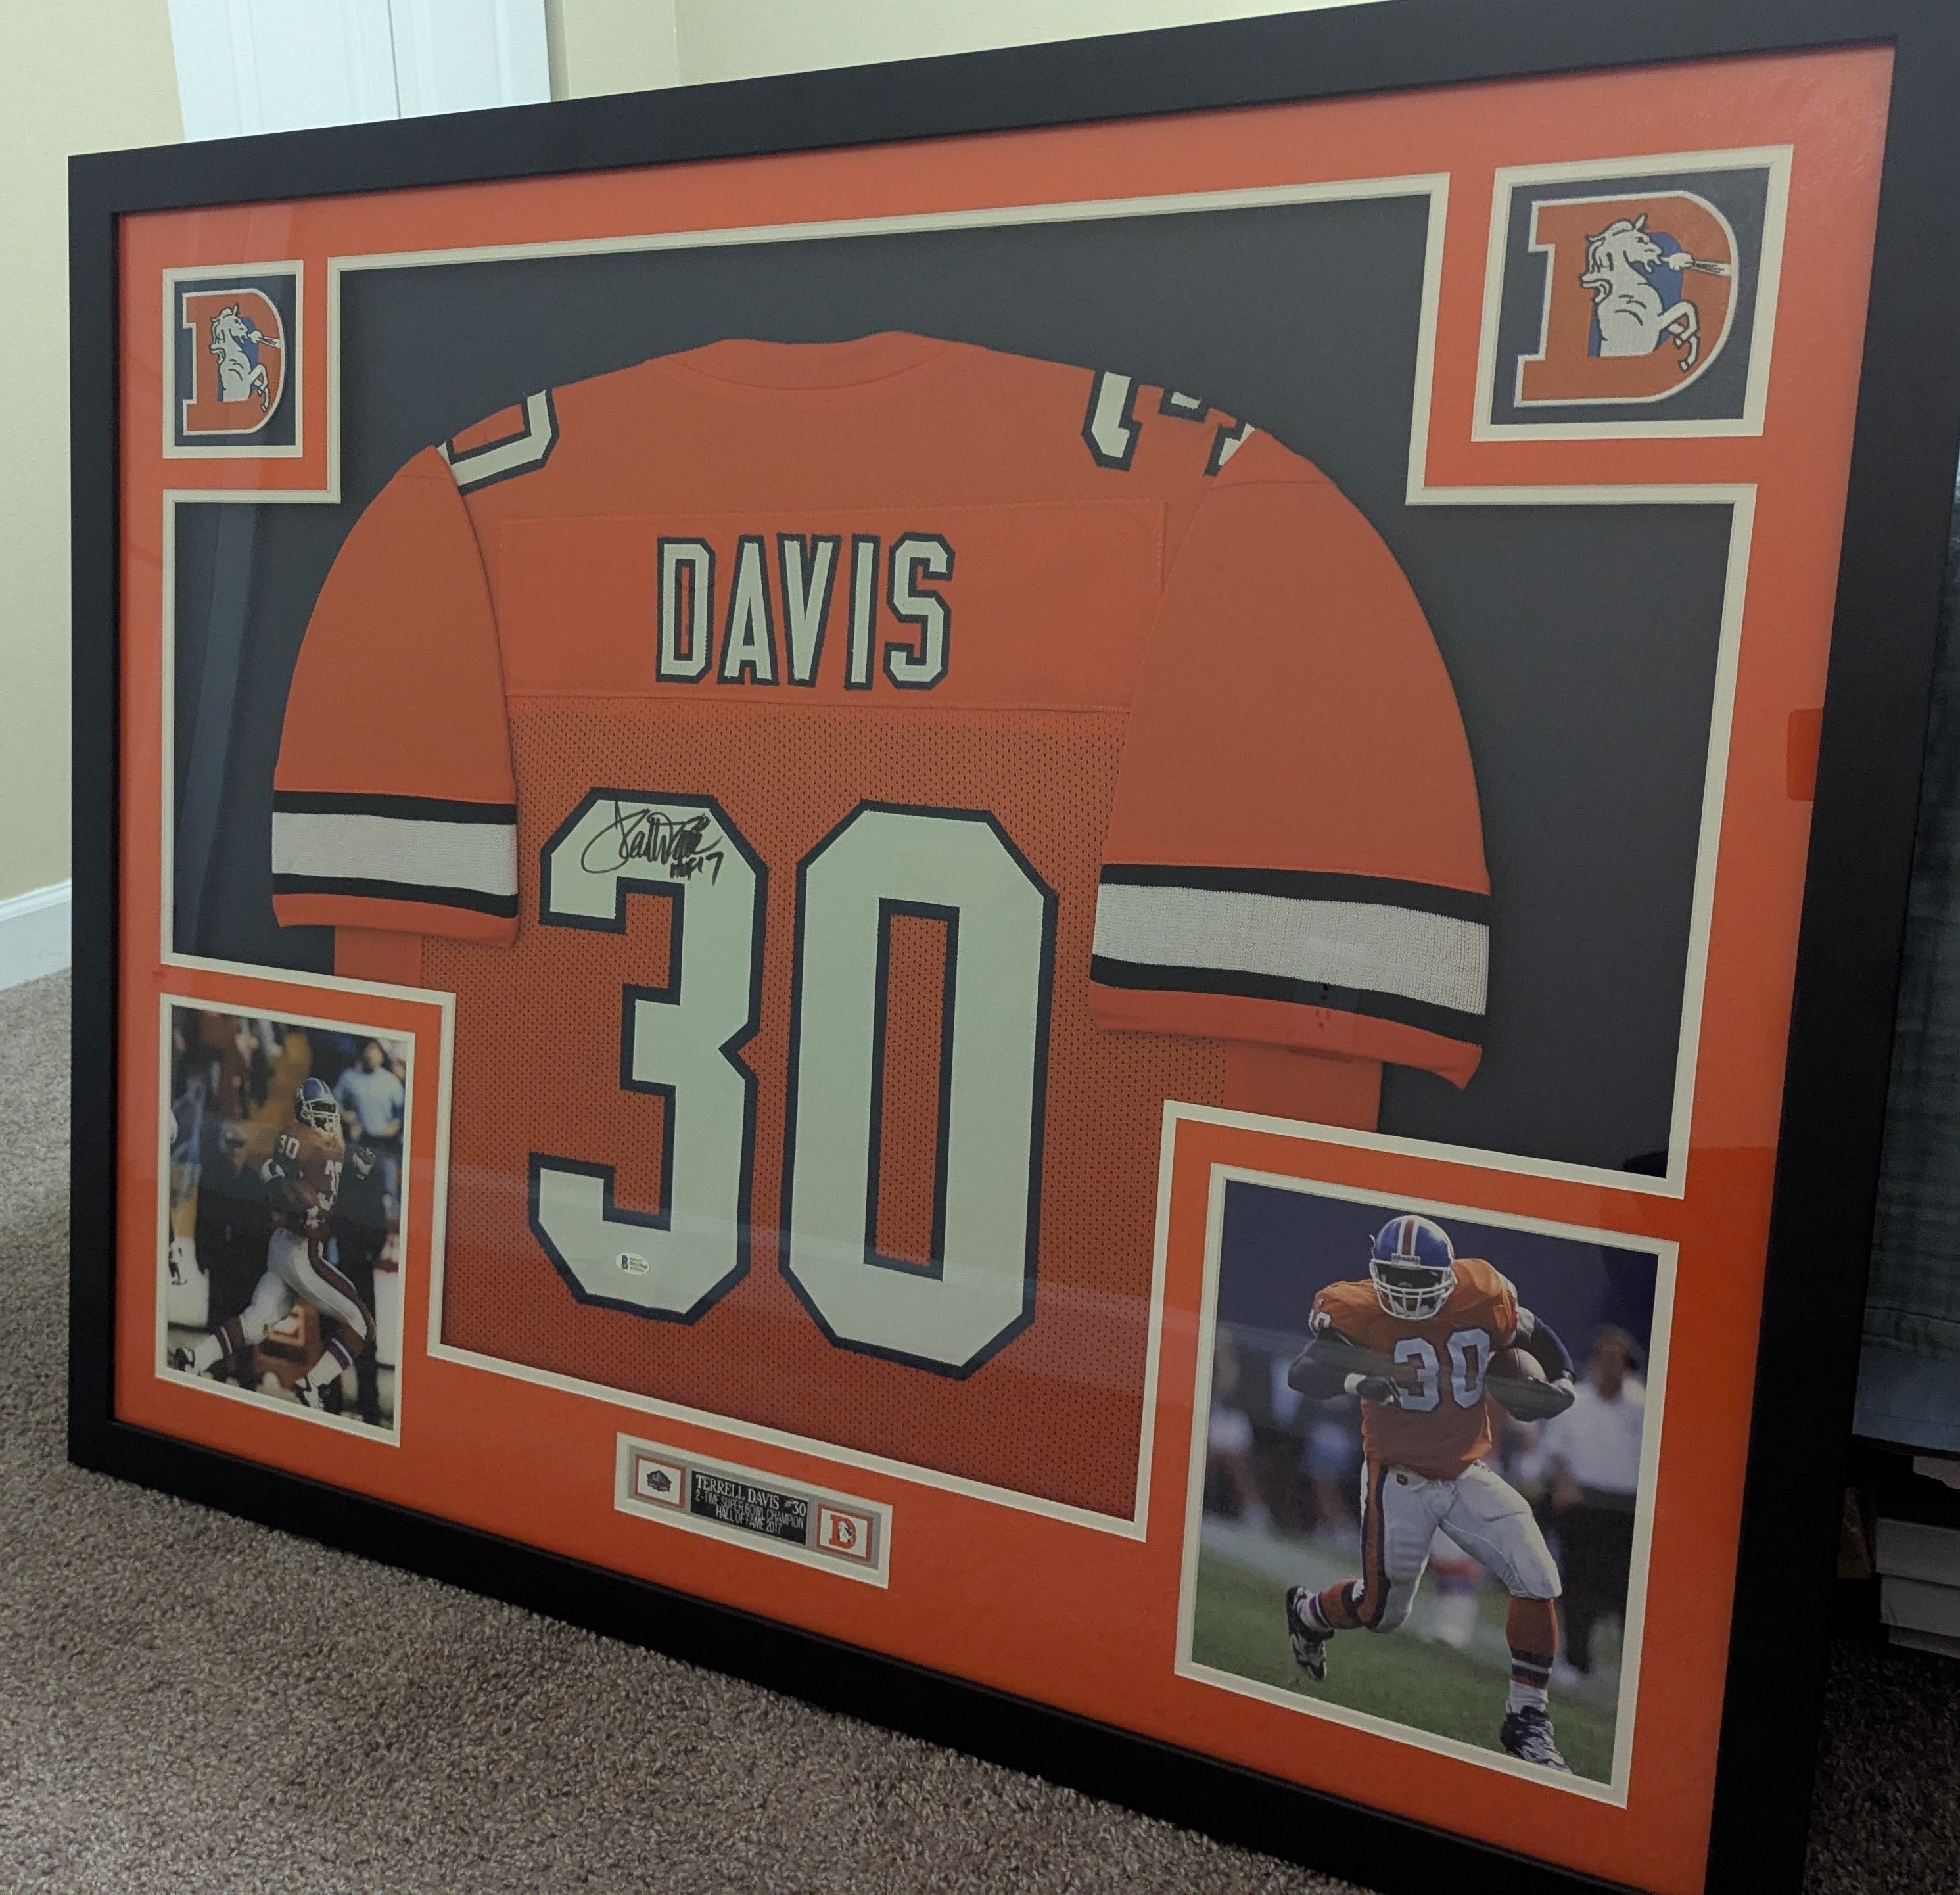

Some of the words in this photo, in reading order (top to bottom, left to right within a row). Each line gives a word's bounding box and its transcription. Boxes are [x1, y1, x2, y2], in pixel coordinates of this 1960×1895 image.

[655, 531, 956, 691] DAVIS
[528, 787, 1059, 1381] 30
[277, 1134, 300, 1160] 30
[1393, 1328, 1491, 1412] 30
[695, 1474, 745, 1501] TERRELL
[748, 1488, 780, 1510] DAVIS
[784, 1499, 806, 1517] #30
[695, 1489, 720, 1505] 2-TIME
[722, 1495, 744, 1512] SUPER
[745, 1502, 766, 1520] BOWL
[766, 1508, 804, 1530] CHAMPION
[716, 1504, 734, 1522] HALL
[734, 1511, 745, 1524] OF
[745, 1514, 765, 1531] FAME
[766, 1520, 782, 1535] 2017
